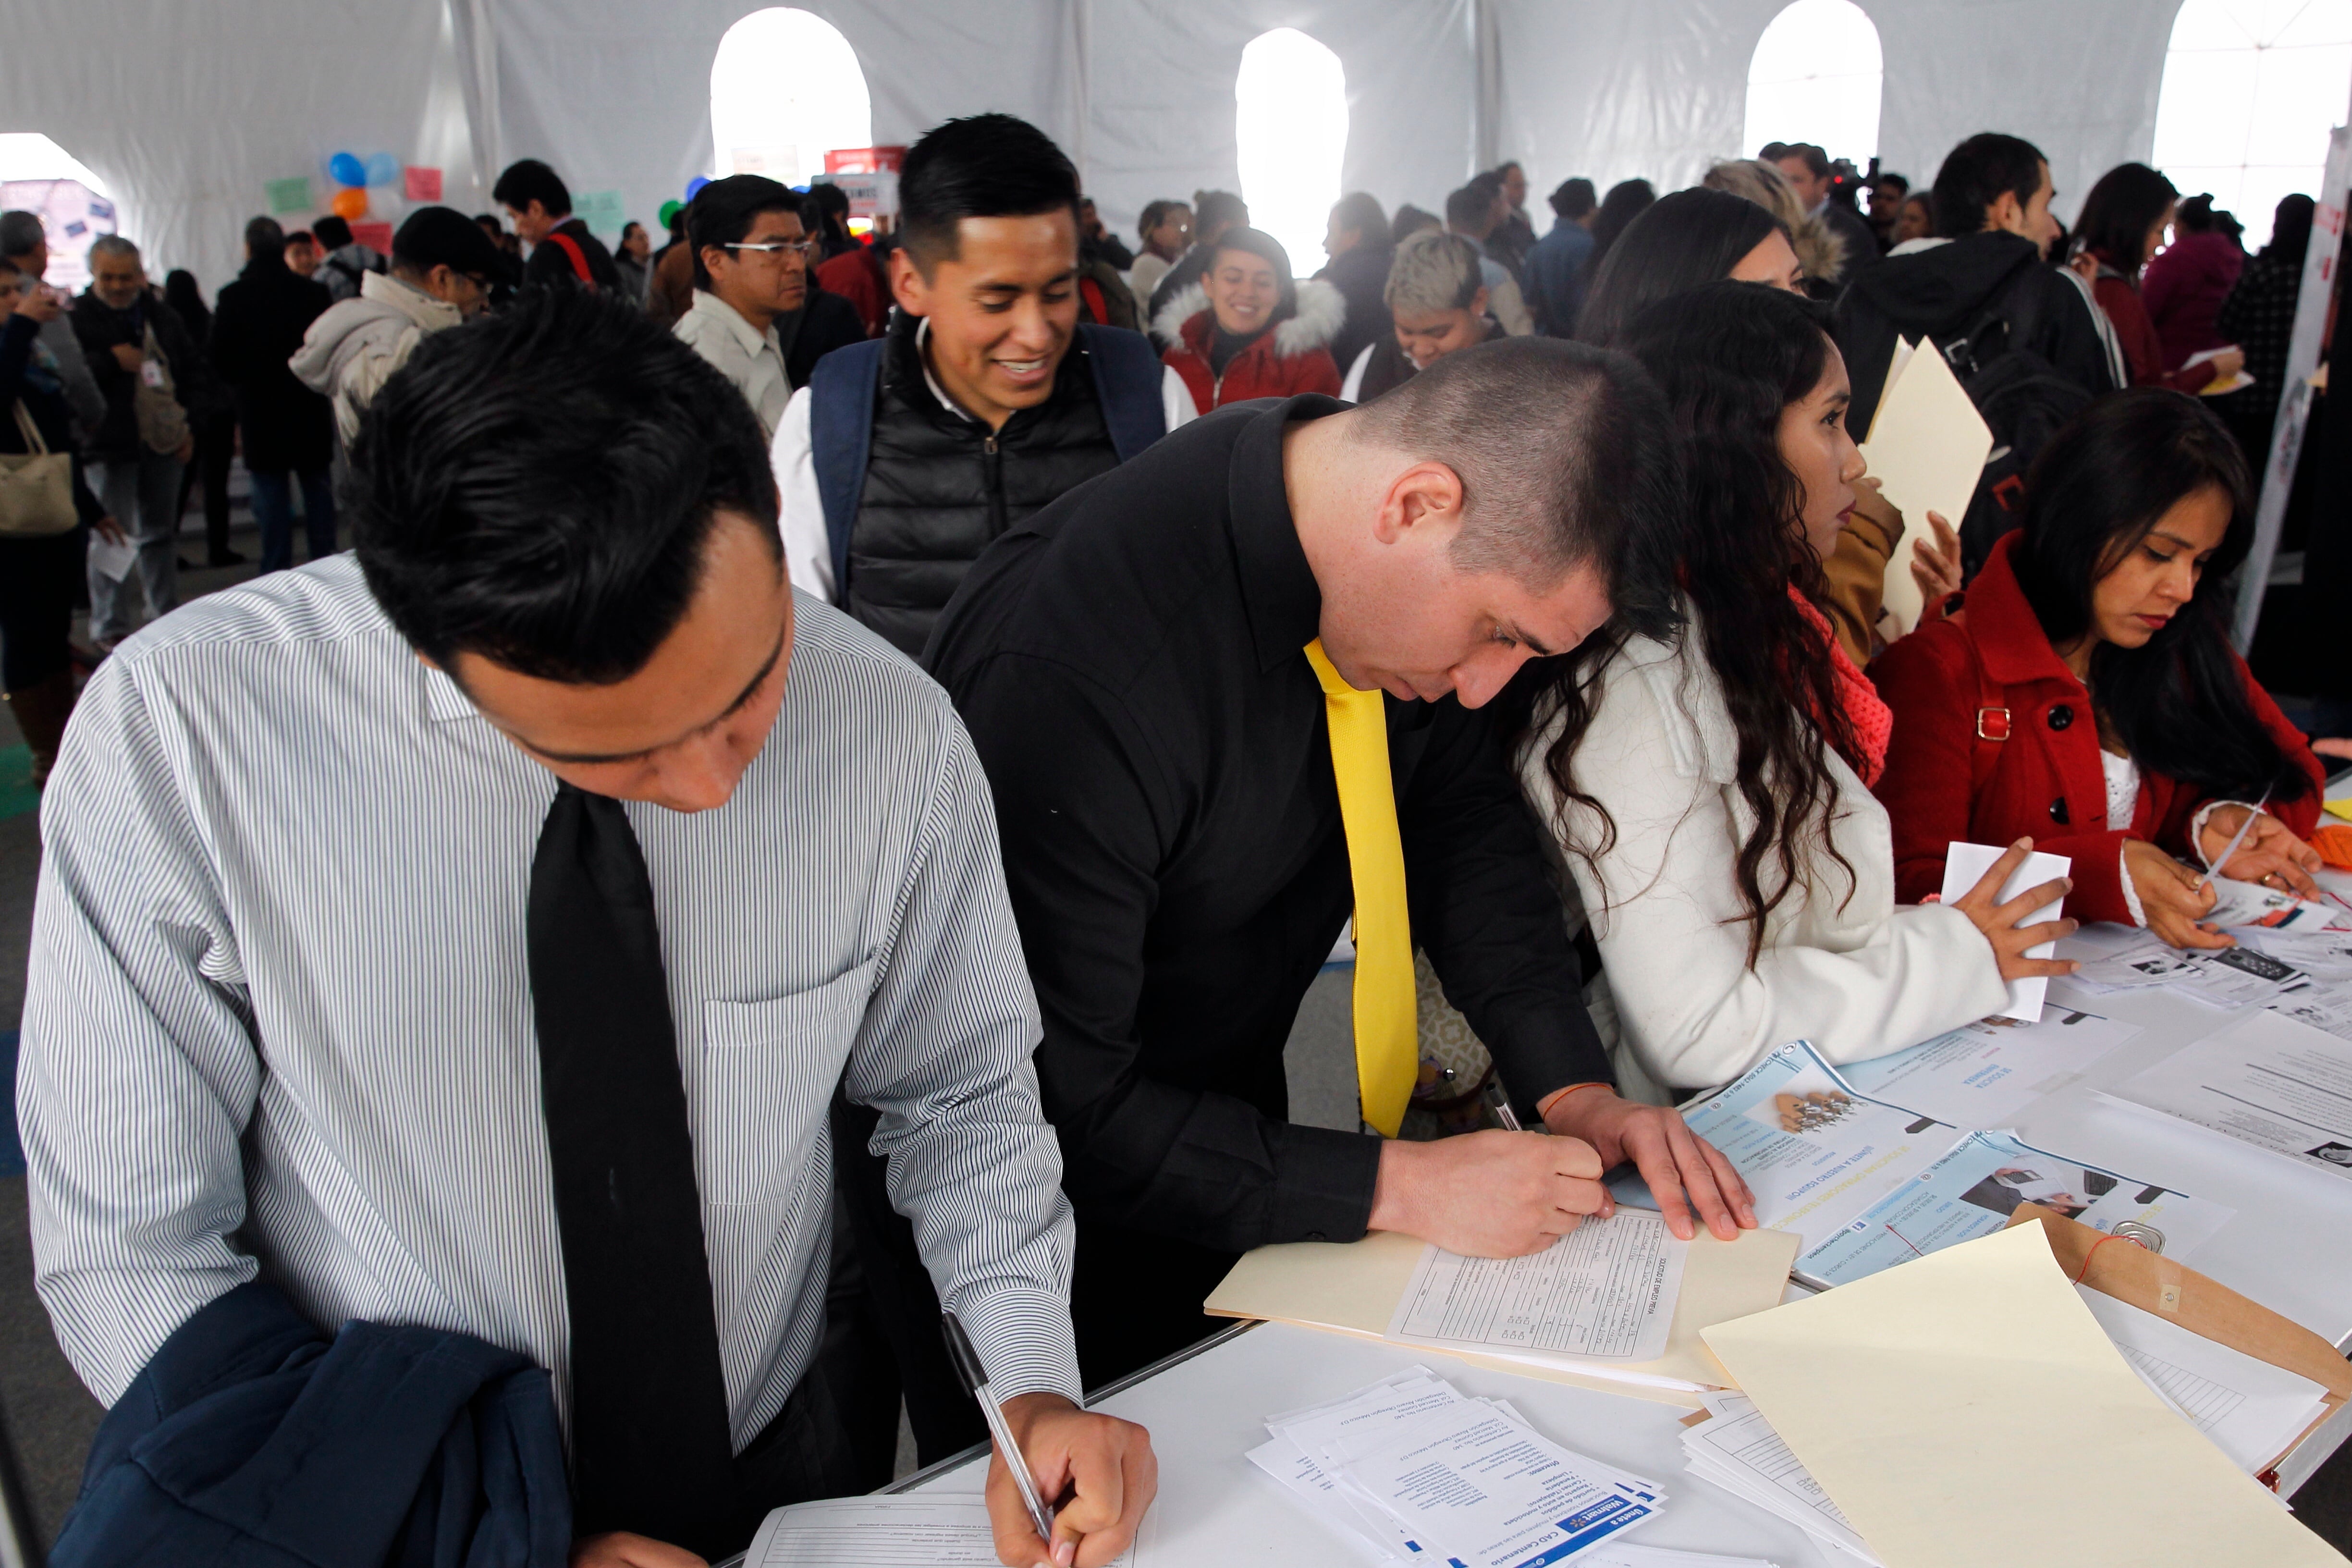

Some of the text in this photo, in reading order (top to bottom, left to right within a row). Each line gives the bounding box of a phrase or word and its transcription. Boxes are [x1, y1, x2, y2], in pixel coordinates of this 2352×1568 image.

[1816, 1164, 1846, 1181] NUESTRO
[1655, 1257, 1667, 1277] SOLICITUD
[1650, 1284, 1661, 1301] EMPLEO
[1647, 1300, 1656, 1315] PREVIA
[1469, 1418, 1498, 1430] Delegación
[1473, 1426, 1493, 1435] Merced
[1455, 1434, 1474, 1443] Gomez
[1472, 1429, 1501, 1441] Centenario
[1428, 1437, 1452, 1448] Obregón
[1405, 1447, 1428, 1458] México
[1528, 1461, 1559, 1476] Ofrecemos:
[1542, 1472, 1568, 1485] Limpieza
[1545, 1476, 1575, 1490] Panadería
[1527, 1481, 1581, 1507] Carnes (Tablajeros)
[1565, 1484, 1589, 1495] Reparto
[1573, 1488, 1595, 1499] Surtido
[1579, 1492, 1607, 1506] Buscamos
[1541, 1502, 1565, 1515] pedidos
[1553, 1506, 1580, 1518] hombres
[1580, 1498, 1625, 1522] Walmart
[1504, 1508, 1538, 1525] motocicleta
[1614, 1507, 1646, 1524] Únete
[1526, 1519, 1549, 1531] mujeres
[1512, 1530, 1526, 1538] para
[1487, 1542, 1503, 1550] áreas
[1491, 1532, 1558, 1565] CAD Centenario
